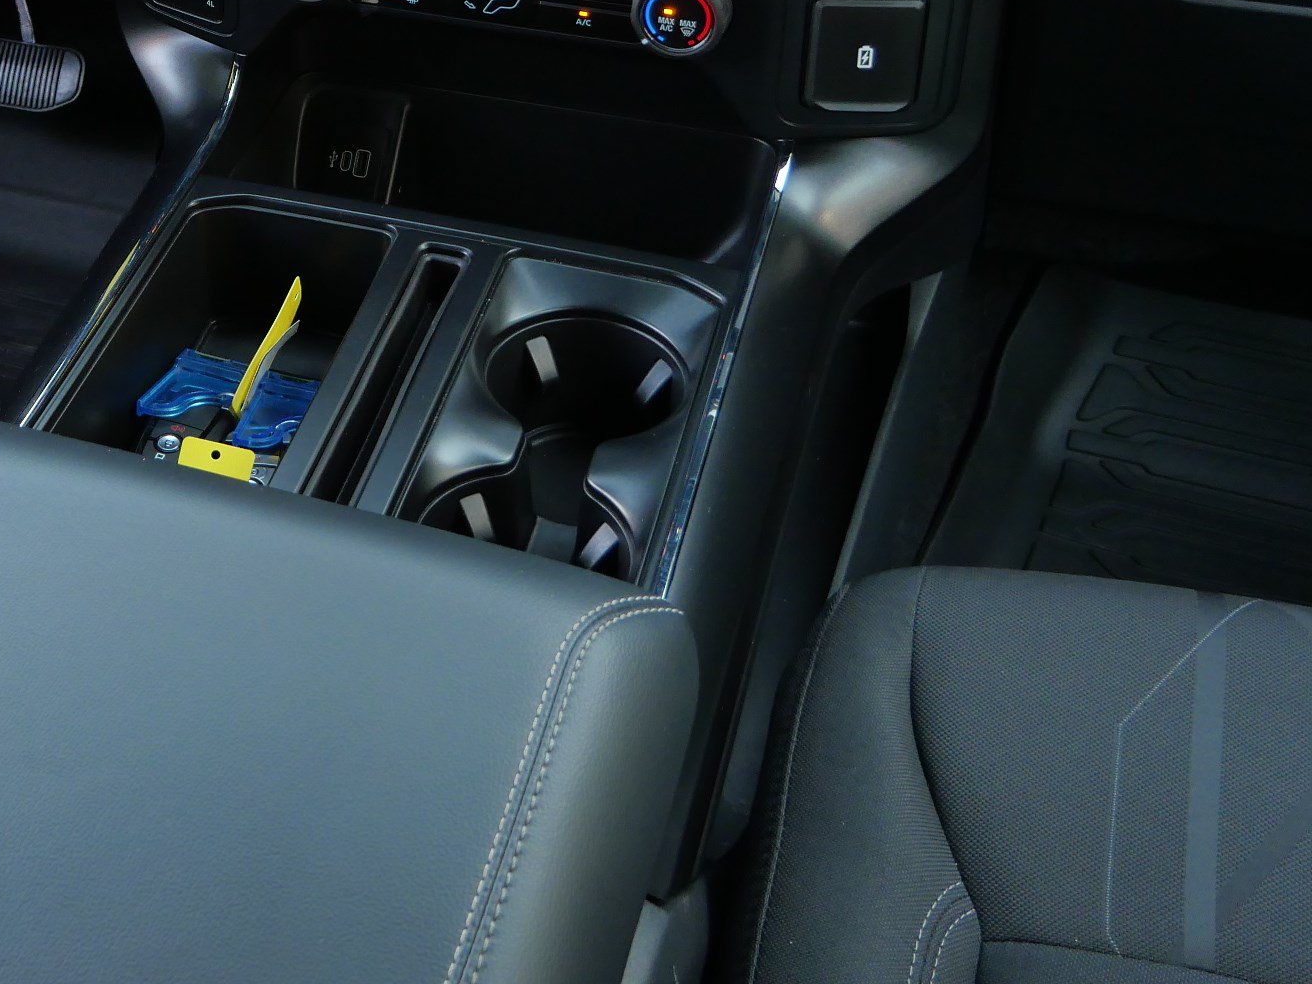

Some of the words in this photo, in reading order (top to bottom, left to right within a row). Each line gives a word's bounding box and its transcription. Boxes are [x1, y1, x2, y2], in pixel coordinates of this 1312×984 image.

[206, 0, 215, 8] 4L
[575, 18, 592, 27] A/C
[657, 16, 675, 26] MAX
[679, 19, 697, 29] MAX
[659, 23, 673, 32] A/C
